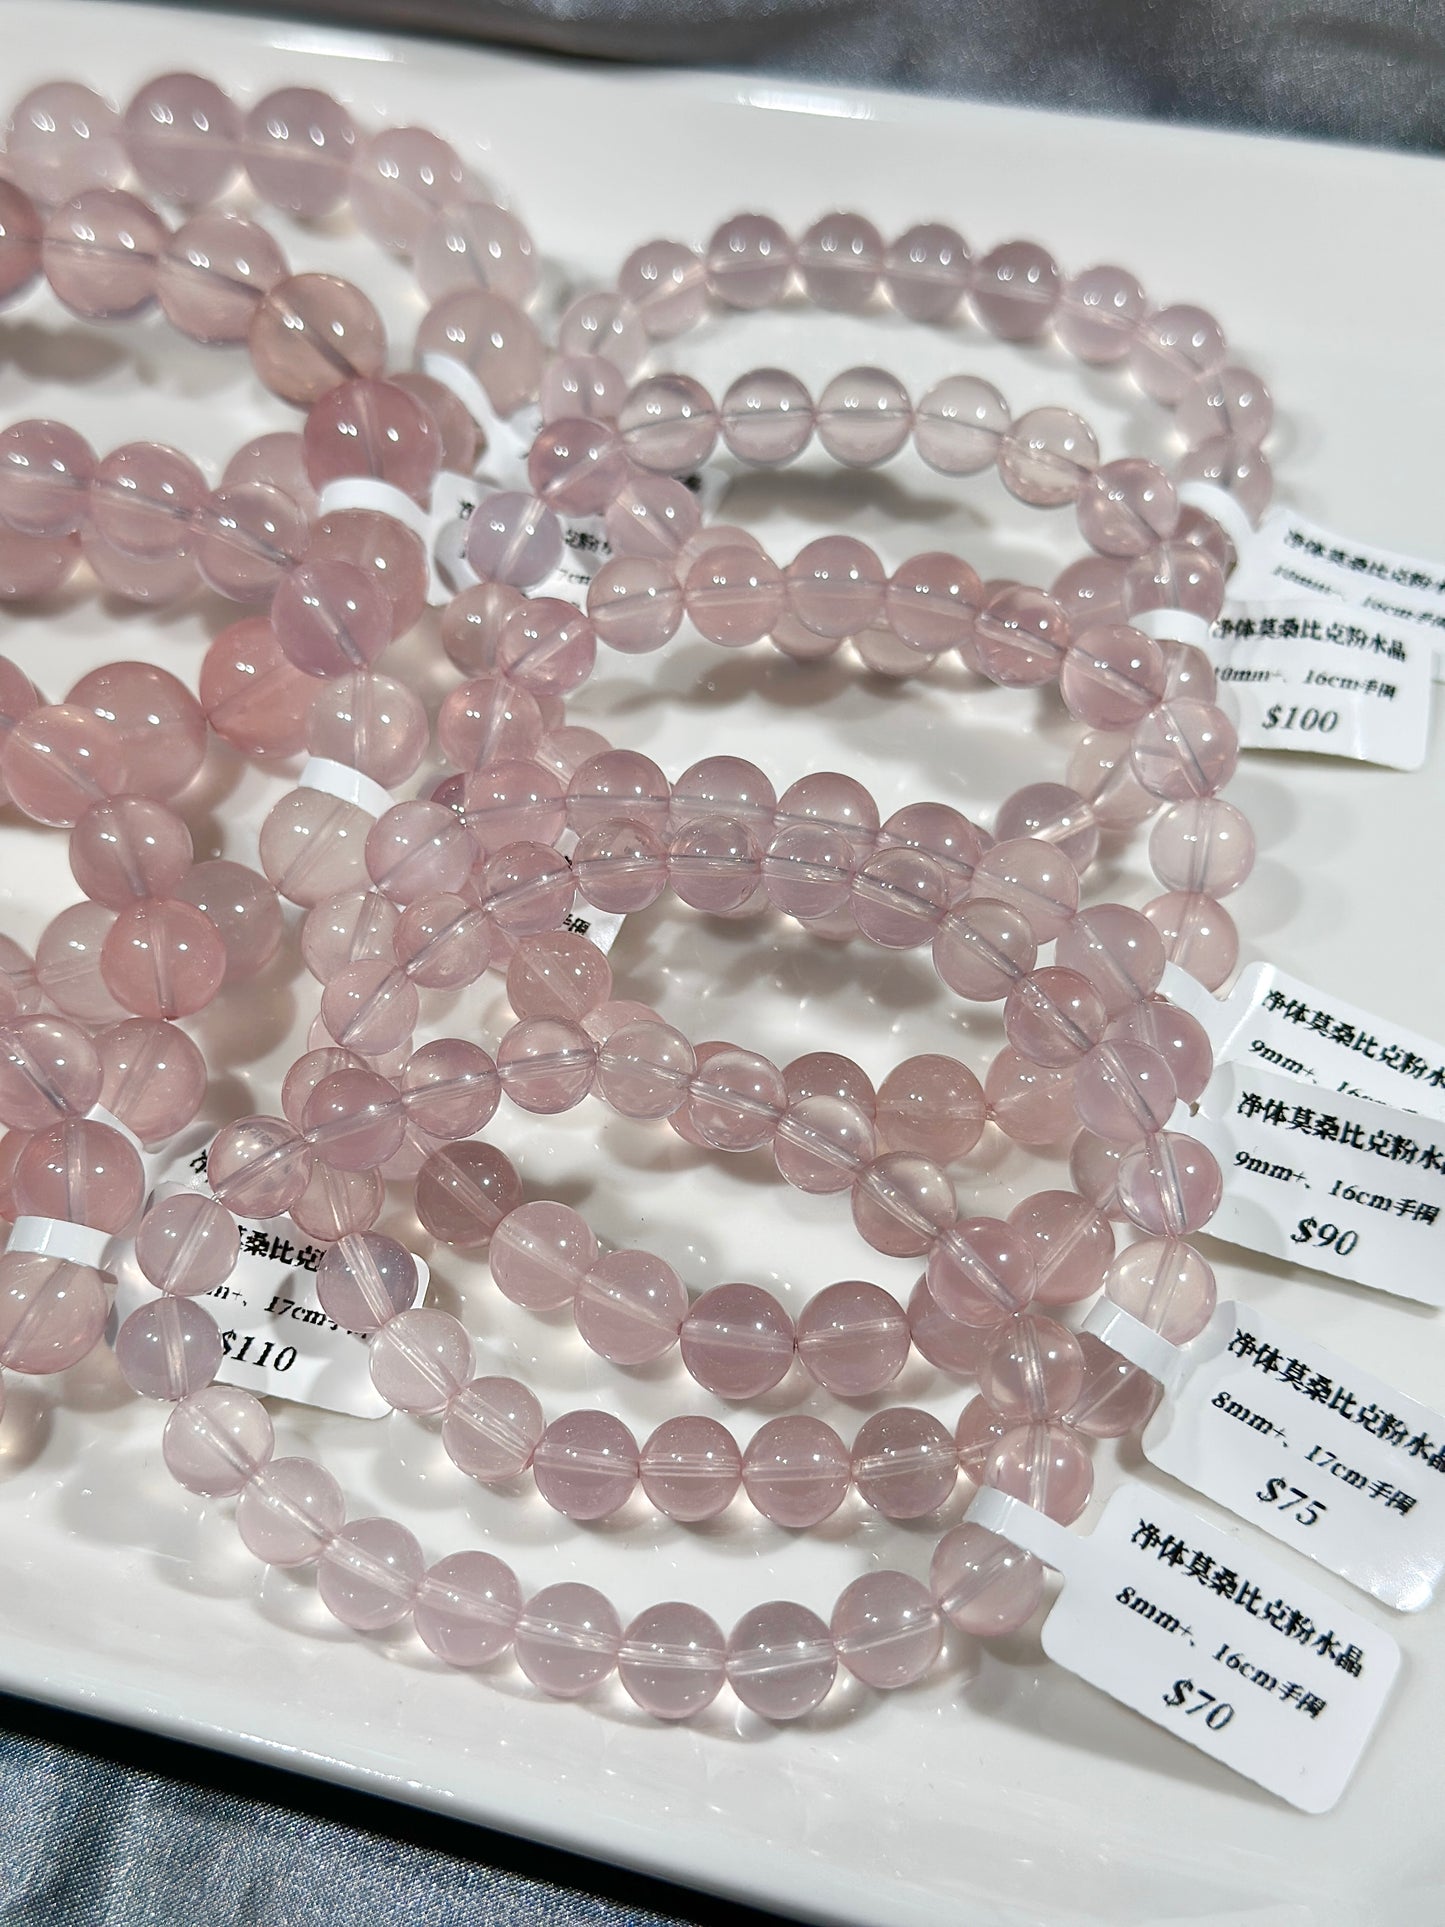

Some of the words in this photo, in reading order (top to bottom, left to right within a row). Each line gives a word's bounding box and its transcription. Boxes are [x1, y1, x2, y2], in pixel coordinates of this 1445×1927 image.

[1262, 704, 1339, 734] $100
[1237, 1091, 1445, 1176] 净体莫桑比克粉水
[1290, 1216, 1359, 1256] $90
[222, 1328, 298, 1373] $110
[1256, 1476, 1328, 1526] $75
[1130, 1518, 1365, 1678] 净体莫桑比克粉水晶
[1162, 1678, 1236, 1731] $70
